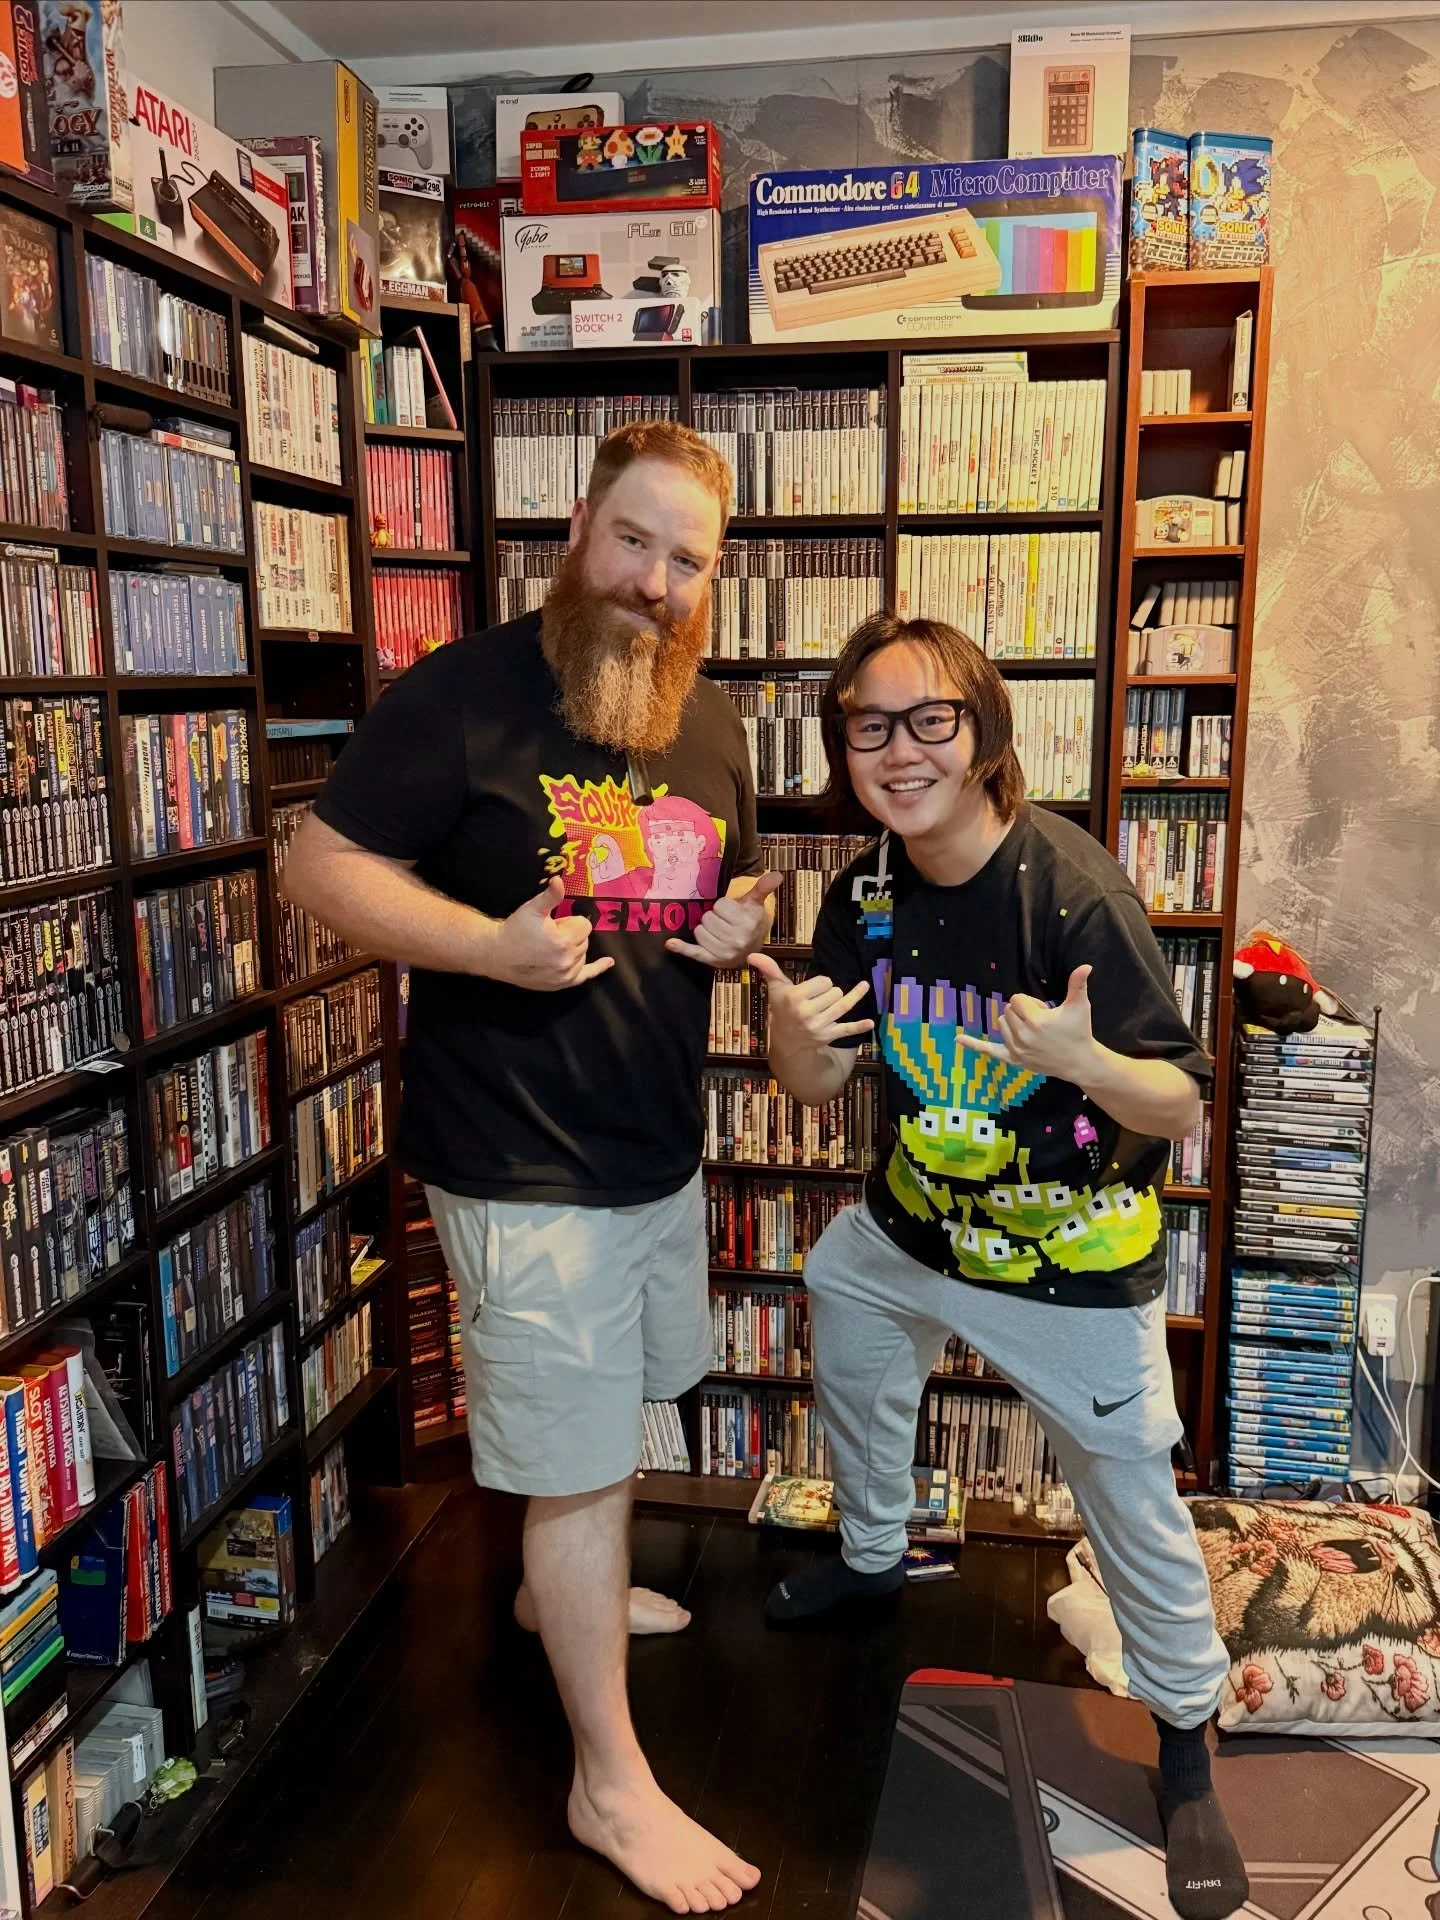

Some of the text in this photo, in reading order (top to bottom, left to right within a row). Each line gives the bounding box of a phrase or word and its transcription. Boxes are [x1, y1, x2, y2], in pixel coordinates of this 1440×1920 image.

[1018, 34, 1043, 43] 8BitDo
[135, 86, 193, 157] ATARI
[526, 142, 542, 150] SUPER
[73, 182, 109, 192] Microsoft
[364, 145, 376, 214] SYSTEM
[388, 173, 413, 184] SONIC
[427, 181, 441, 192] 298
[756, 165, 1110, 205] Commodore 64 MicroComputer
[670, 221, 696, 236] GO
[757, 208, 768, 216] High
[768, 207, 792, 215] Resolution
[798, 206, 813, 214] Sound
[813, 205, 840, 213] Synthesizer
[1219, 222, 1254, 233] SONIC
[517, 226, 549, 253] Yobo
[1146, 244, 1187, 262] REMI
[1207, 245, 1266, 263] REMIX
[389, 281, 430, 298] EGGMAN
[575, 313, 623, 323] SWITCH 2
[575, 324, 604, 333] DOCK
[907, 321, 953, 331] COMPUTER
[1031, 430, 1041, 478] EPIC MICKEY
[1050, 486, 1058, 500] $10
[987, 576, 996, 635] ACME ARSENAL
[46, 712, 55, 752] FIGHTERS
[239, 717, 249, 784] CRACK DOWN
[66, 723, 77, 787] ROBO PIT
[141, 740, 149, 777] ANDRETTI
[1119, 831, 1127, 865] AZURIK
[21, 917, 35, 988] PANZER DRAGOON
[34, 924, 42, 954] SONIC
[52, 919, 61, 957] SONIC
[1201, 1019, 1209, 1038] auto
[179, 1075, 188, 1113] LOTUS
[190, 1076, 199, 1108] LOTUS
[1, 1184, 17, 1241] Magic Carpet
[27, 1172, 38, 1225] SPACE HULK
[88, 1214, 100, 1272] 32X
[219, 1222, 229, 1271] SONIC 2
[28, 1387, 47, 1489] SLOT MACHINE
[44, 1398, 56, 1468] DEMON ATTACK
[58, 1384, 74, 1467] KEYSTONE KAPERS
[14, 1408, 31, 1517] MEGA FUNPAK
[1, 1474, 15, 1531] ACTION
[3, 1533, 18, 1566] PAK
[154, 1575, 162, 1620] ARMADA
